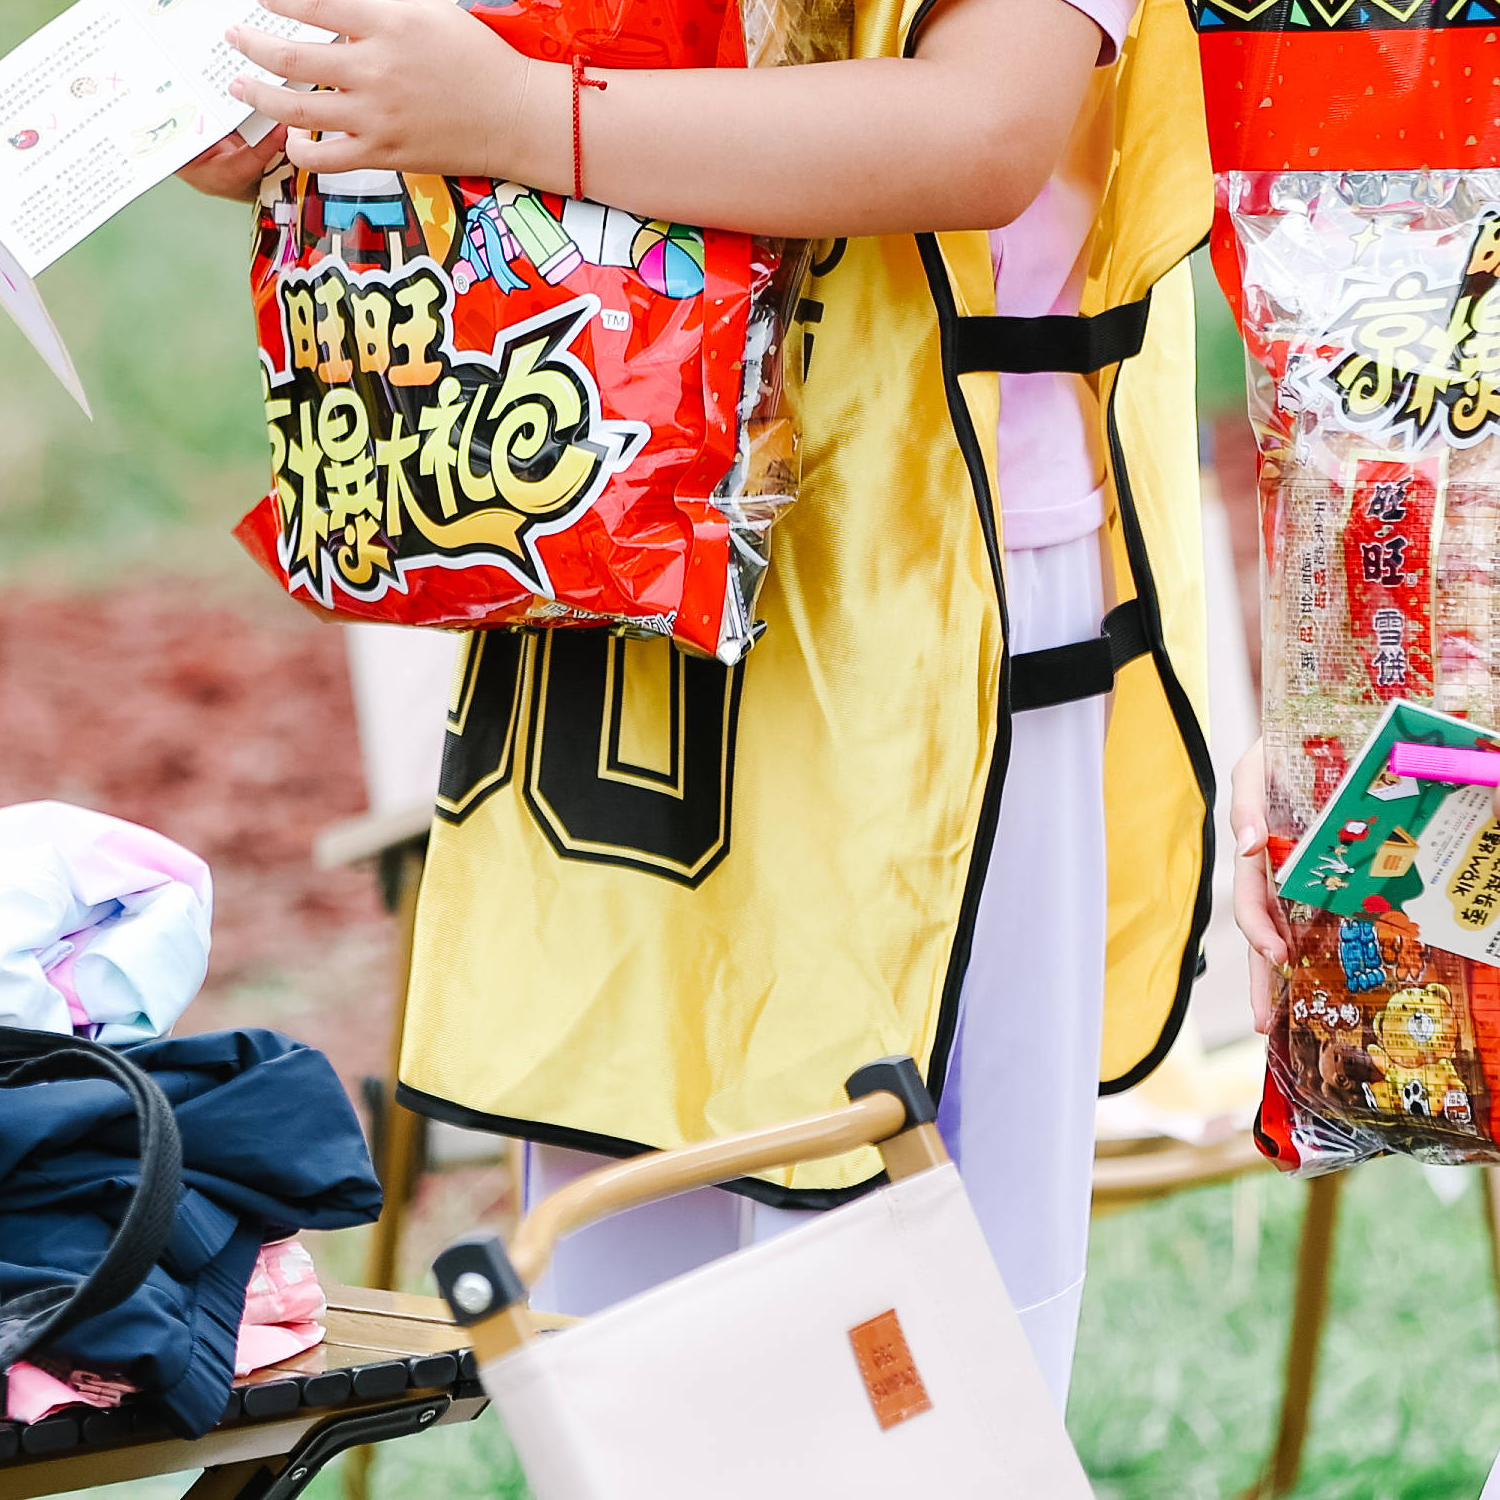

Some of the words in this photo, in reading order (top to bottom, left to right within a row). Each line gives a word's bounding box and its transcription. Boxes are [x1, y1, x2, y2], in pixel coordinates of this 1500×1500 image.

[284, 275, 443, 387] 旺旺
[1360, 476, 1413, 588] 旺旺
[1373, 608, 1406, 686] 雪饼
